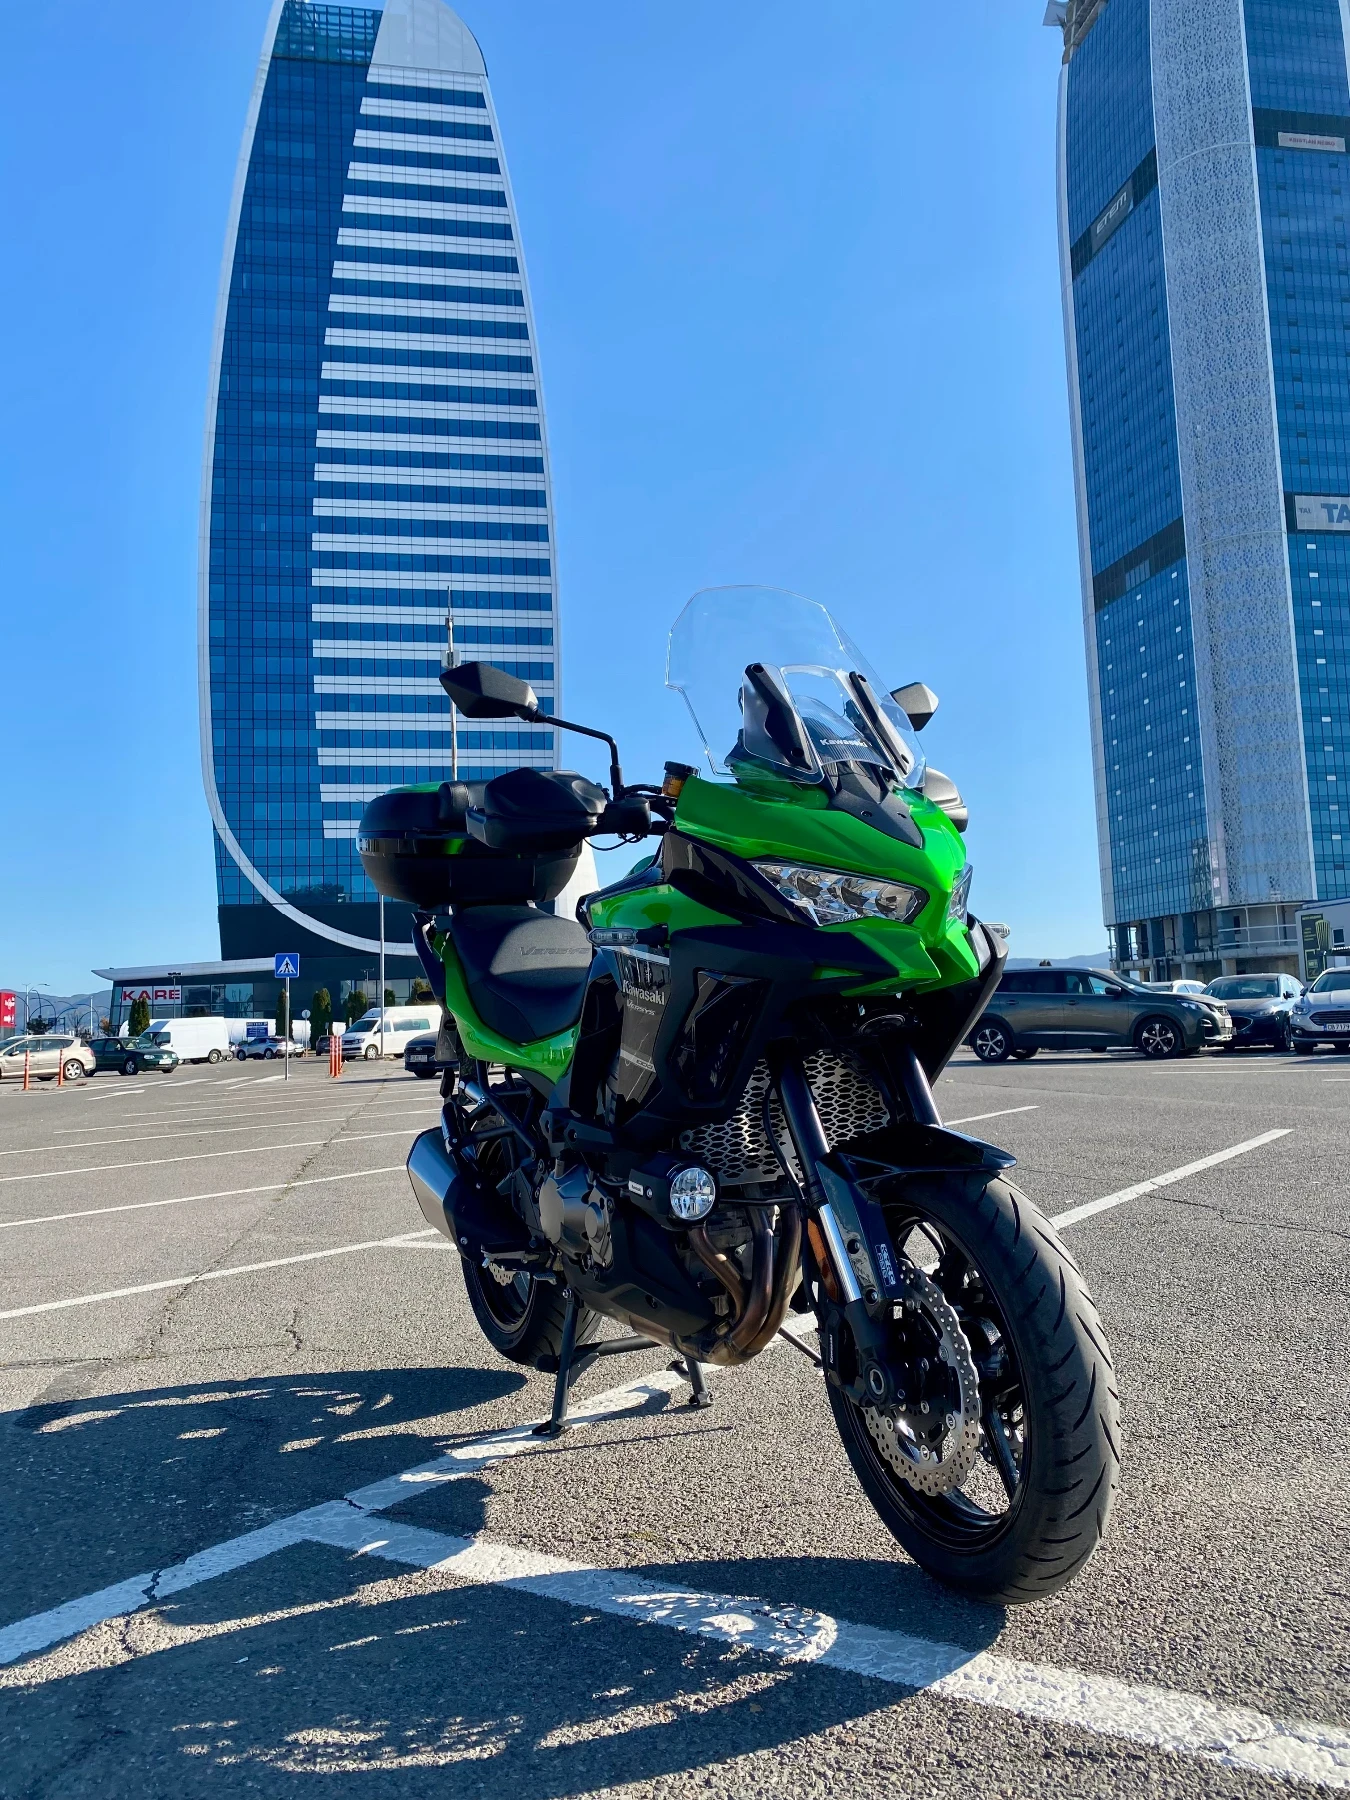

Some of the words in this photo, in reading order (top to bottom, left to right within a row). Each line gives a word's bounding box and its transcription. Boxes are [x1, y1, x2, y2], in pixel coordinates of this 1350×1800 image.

[1096, 191, 1127, 234] ETEM
[819, 738, 868, 748] Kawasaki
[122, 989, 180, 1001] KARE
[622, 979, 665, 1006] Kawasaki
